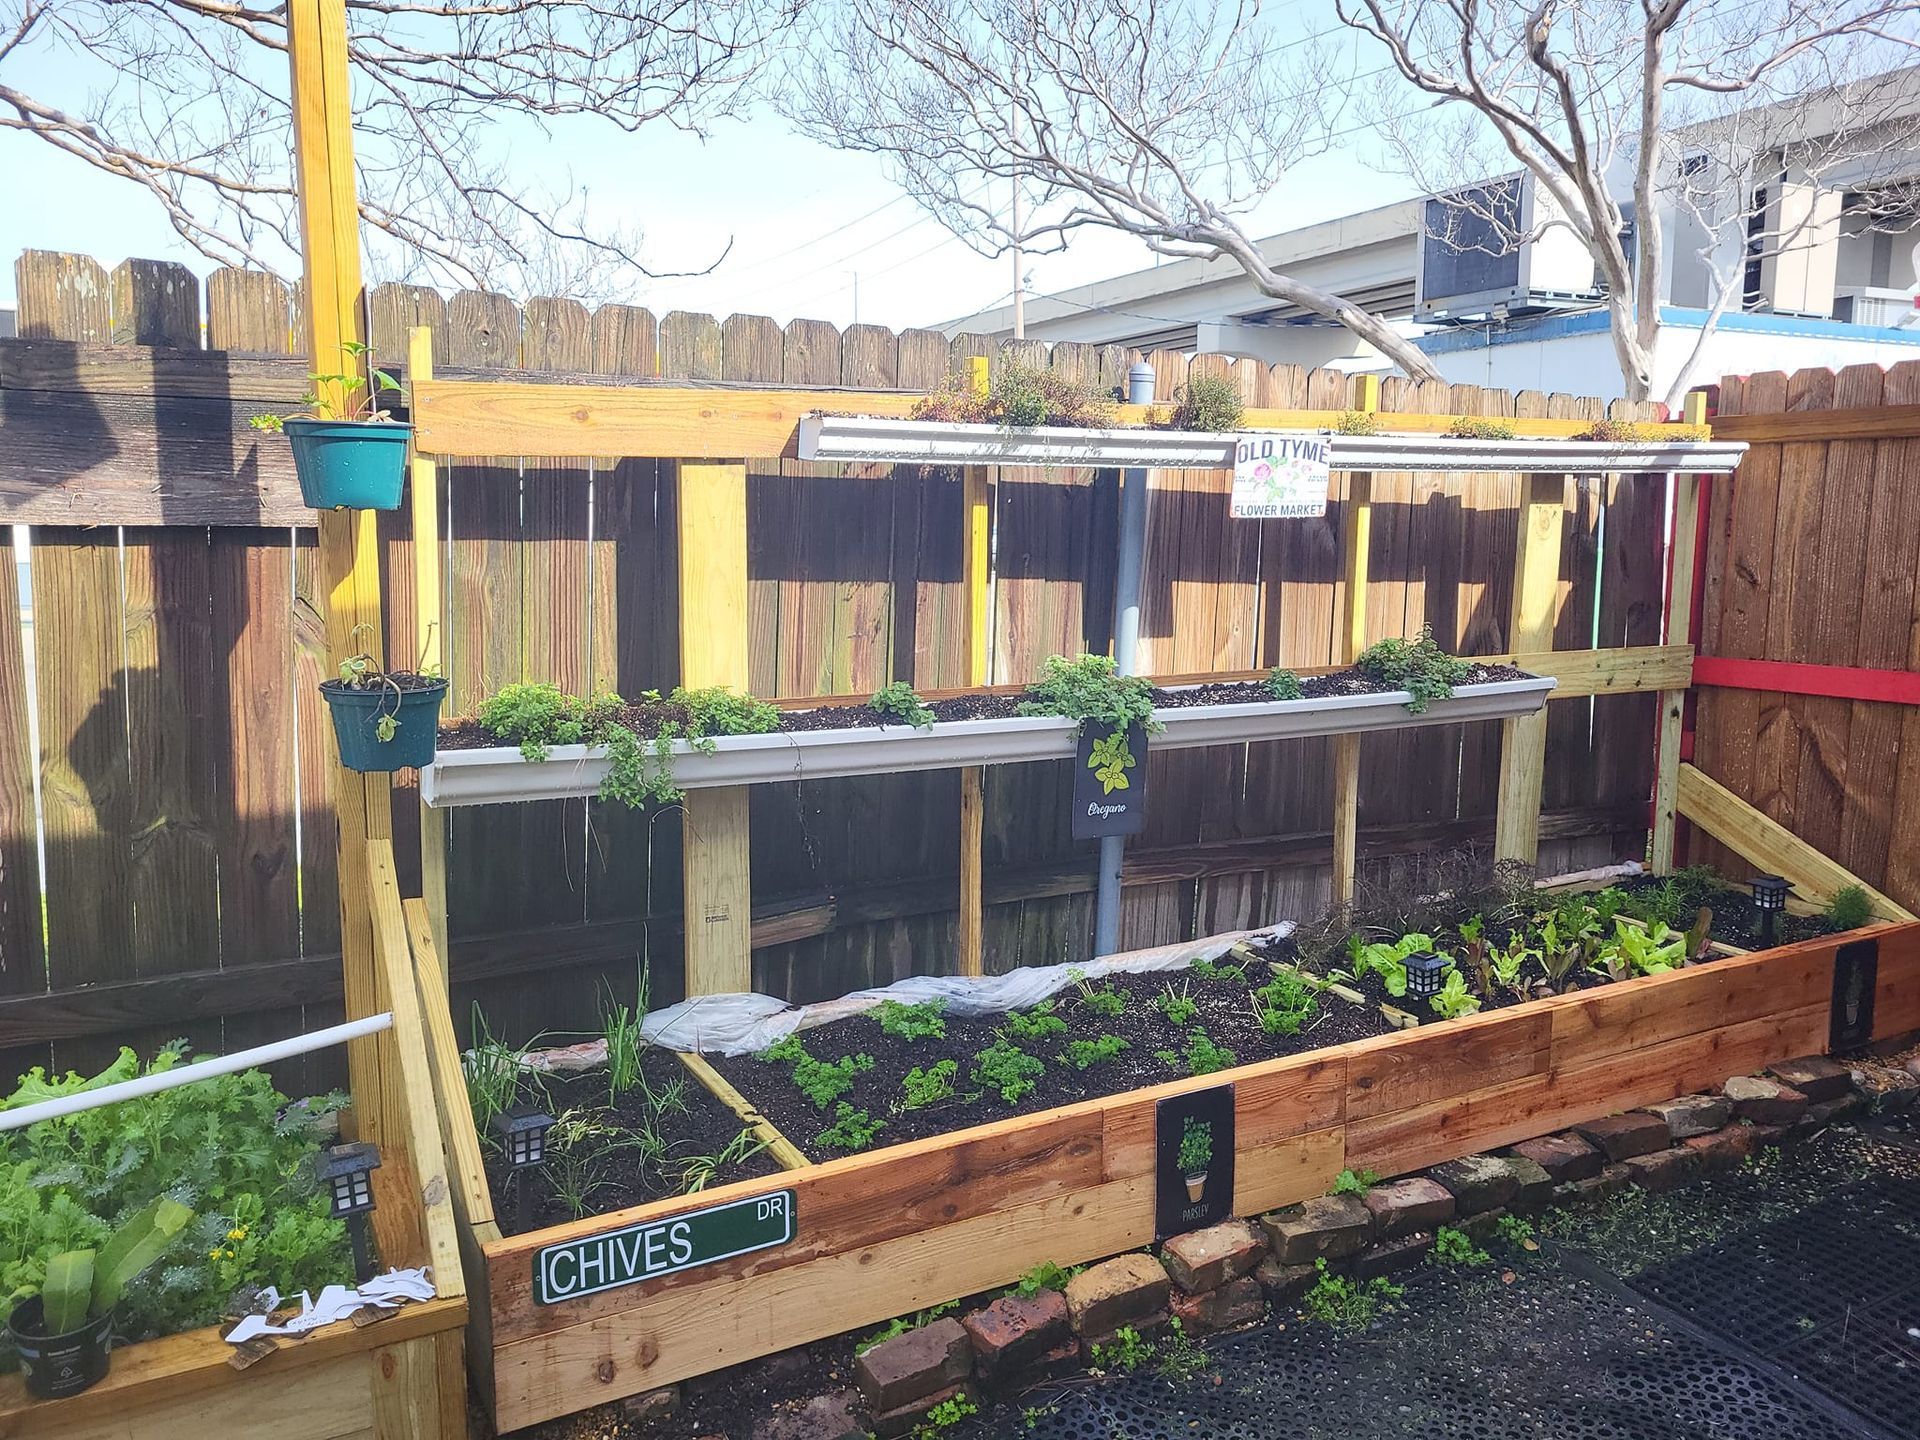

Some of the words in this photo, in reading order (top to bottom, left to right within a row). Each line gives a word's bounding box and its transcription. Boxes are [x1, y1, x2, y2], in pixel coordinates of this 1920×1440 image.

[1237, 439, 1273, 464] OLD
[1280, 439, 1330, 465] TYME
[1234, 504, 1277, 516] FLOWER
[1280, 504, 1324, 516] MARKET
[1087, 801, 1127, 820] Oregano
[1182, 1203, 1210, 1222] PARSLEY
[549, 1221, 693, 1295] CHIVES
[757, 1197, 783, 1221] DR
